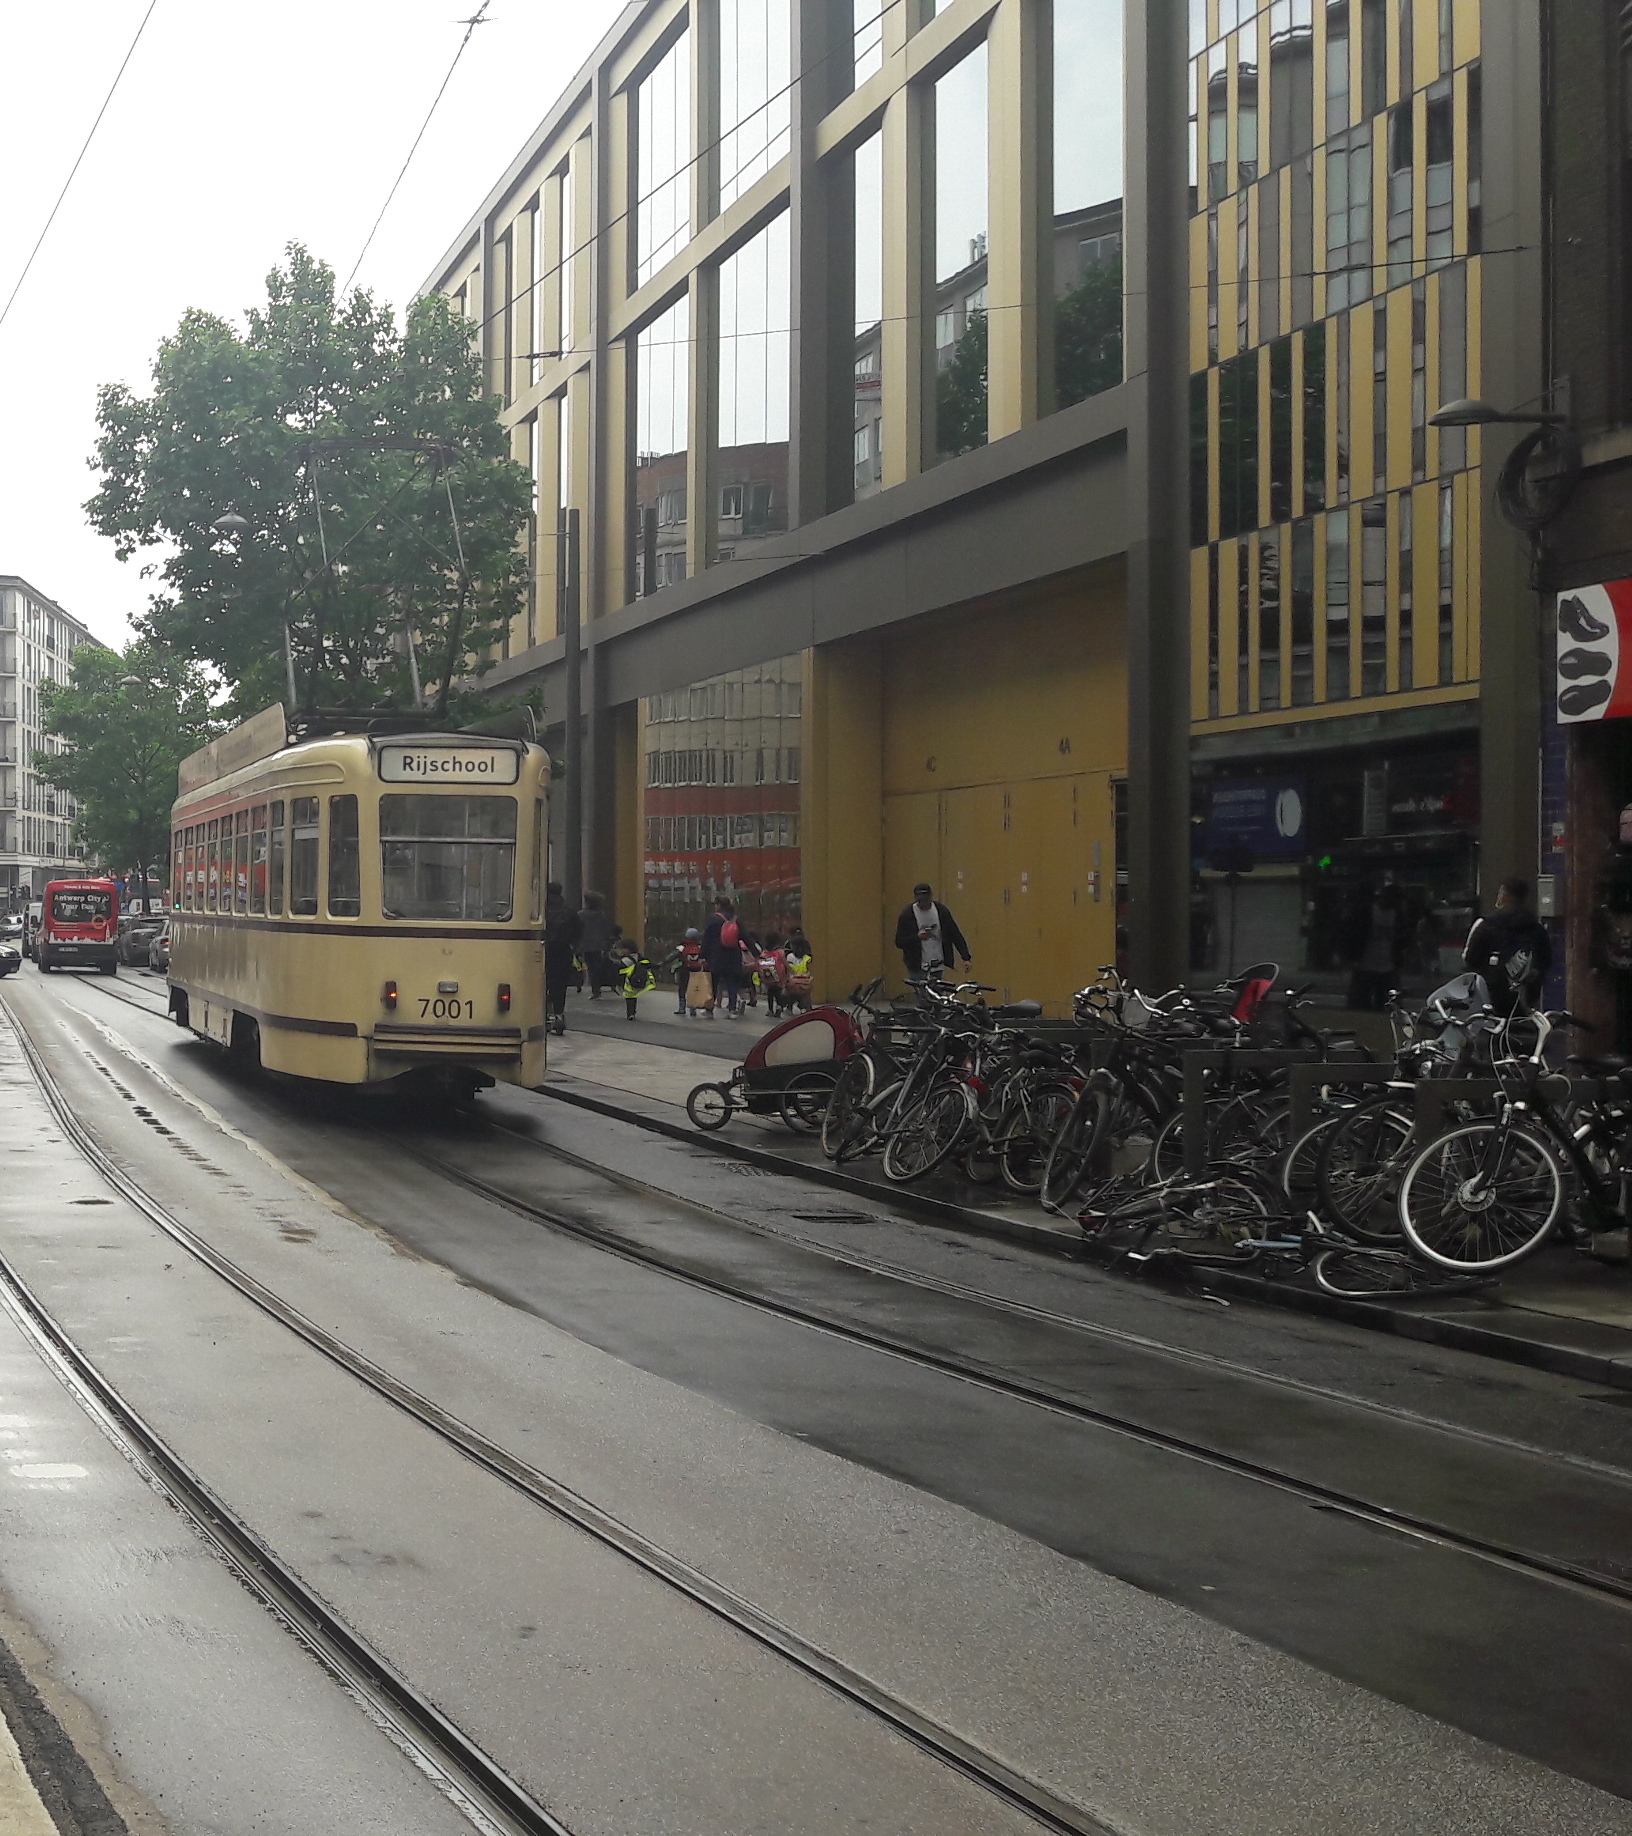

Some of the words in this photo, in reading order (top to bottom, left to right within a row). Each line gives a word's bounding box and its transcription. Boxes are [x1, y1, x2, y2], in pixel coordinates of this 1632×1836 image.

[1058, 737, 1071, 754] 4A
[402, 755, 495, 776] Rijschool
[54, 894, 85, 903] Antwerp
[87, 895, 101, 903] City
[418, 998, 474, 1020] 7001
